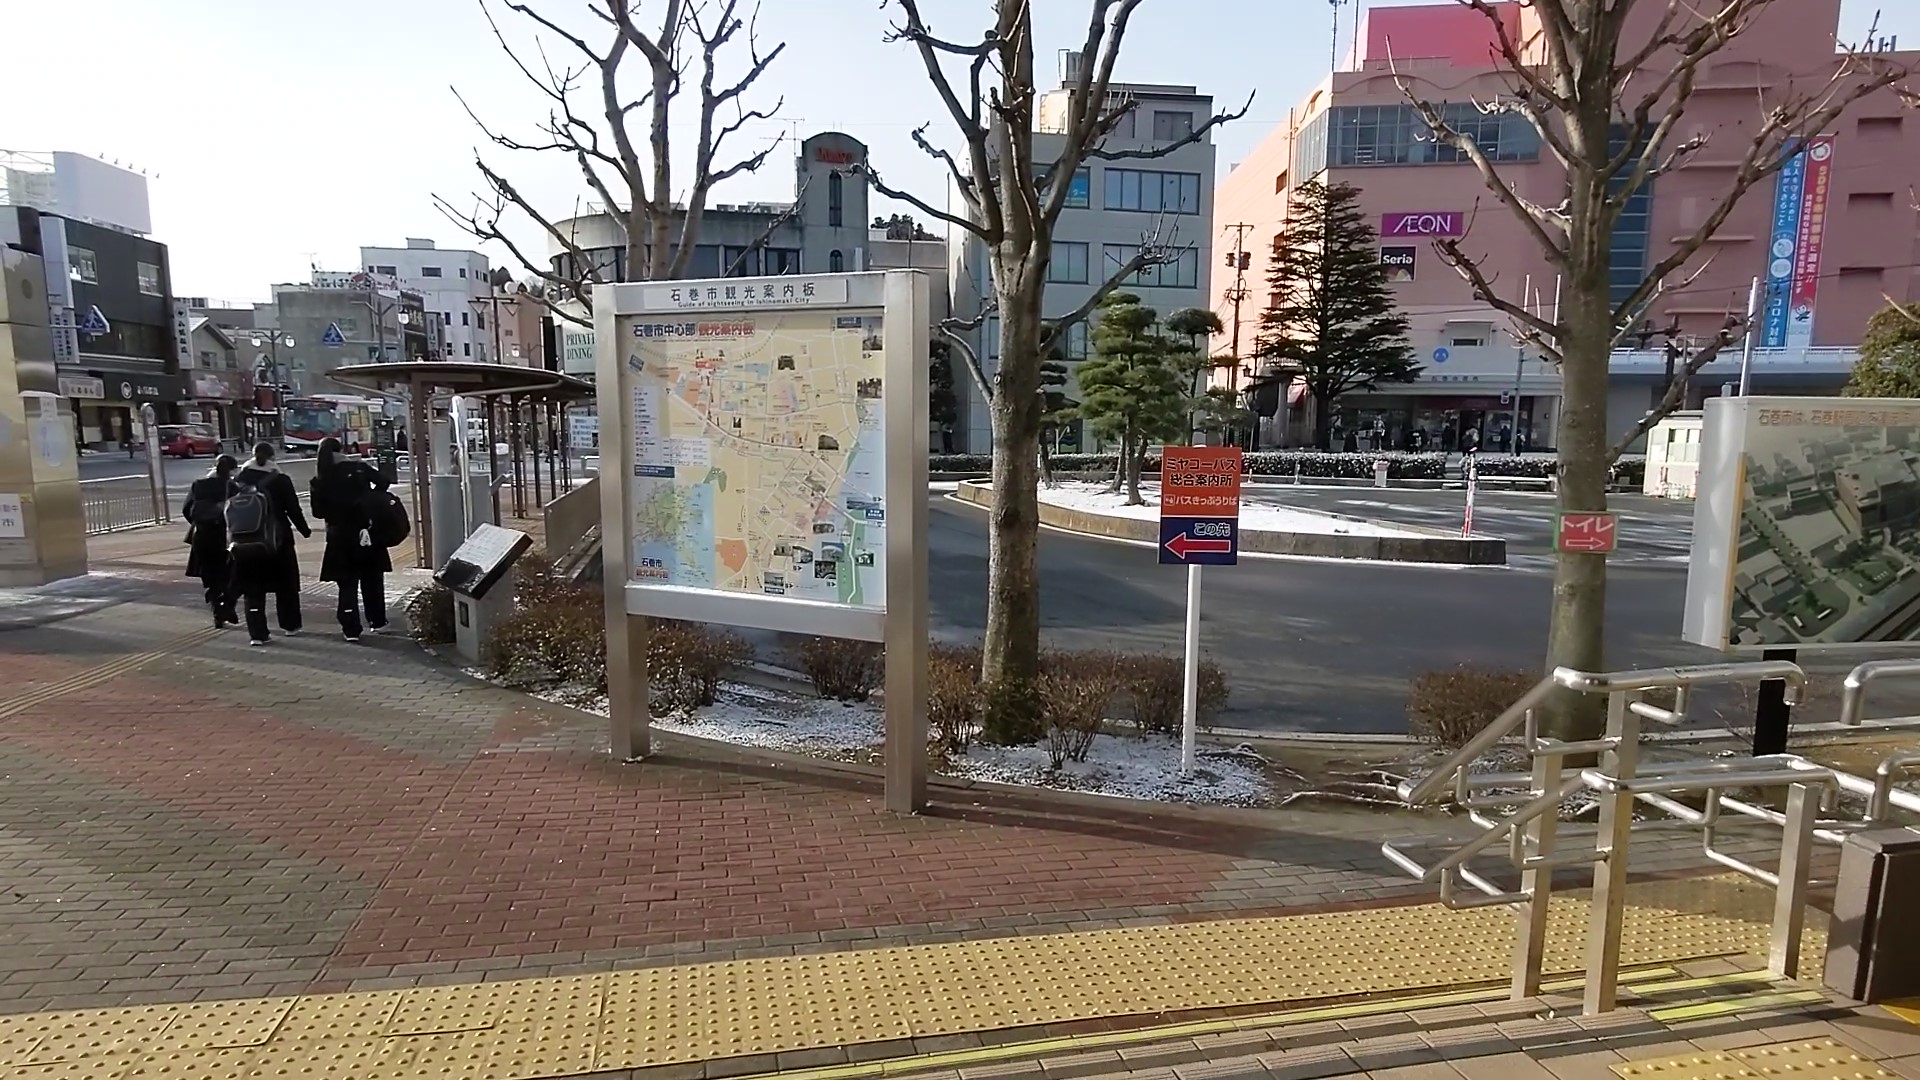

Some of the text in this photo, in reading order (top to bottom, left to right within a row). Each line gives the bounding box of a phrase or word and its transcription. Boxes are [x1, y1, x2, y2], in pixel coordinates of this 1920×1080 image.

[1383, 253, 1413, 264] Seria
[671, 282, 815, 301] 石巻市観光案内板
[633, 323, 696, 337] 石巻市中心部
[566, 333, 595, 345] PRIVAT
[567, 348, 592, 360] DINING
[1166, 458, 1237, 471] ミヤコーバス
[1170, 473, 1232, 487] 総合案内所
[1194, 522, 1231, 536] この先
[1560, 516, 1614, 533] トイレ
